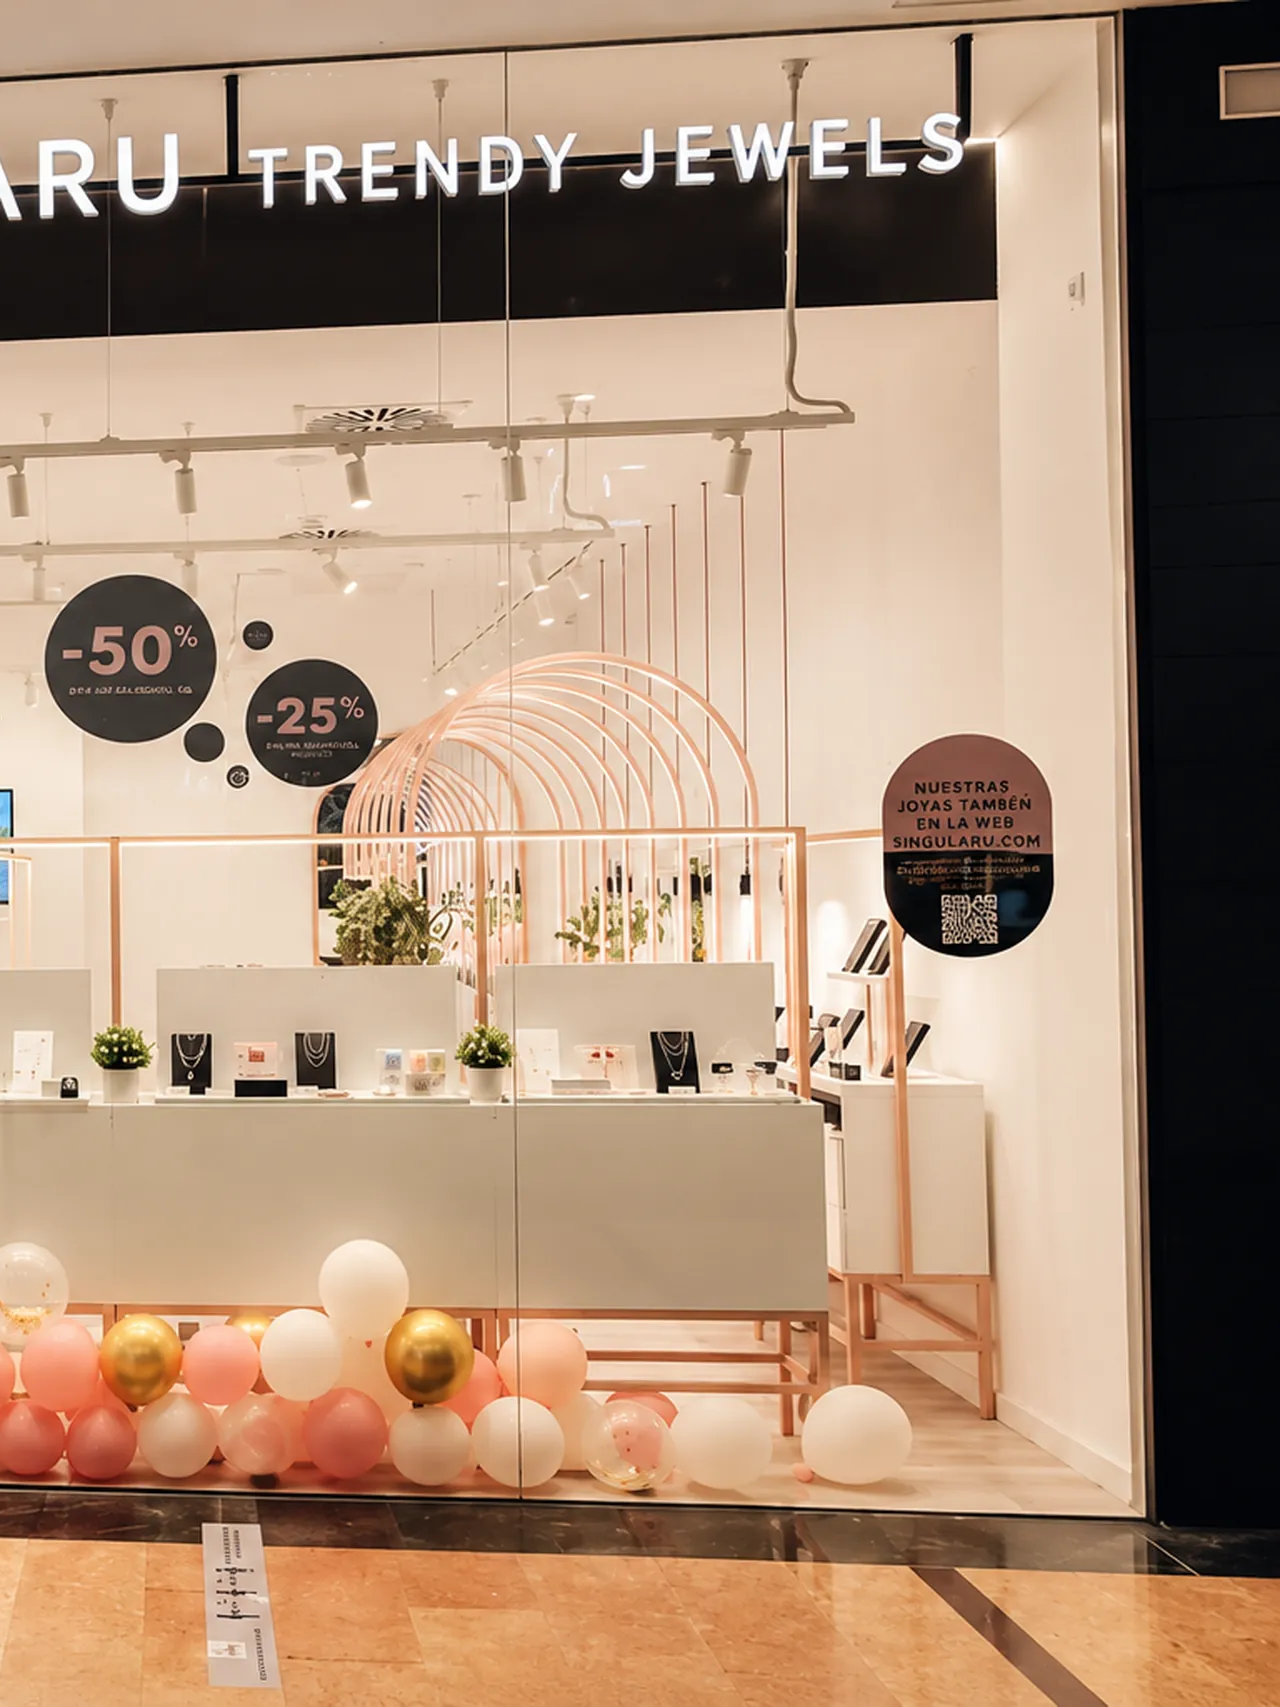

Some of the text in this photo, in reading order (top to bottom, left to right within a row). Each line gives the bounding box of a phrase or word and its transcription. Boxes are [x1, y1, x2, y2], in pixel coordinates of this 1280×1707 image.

[247, 131, 578, 208] TRENDY
[620, 112, 966, 190] JEWELS
[62, 624, 199, 676] -50%
[256, 695, 365, 735] -25%
[914, 780, 1010, 795] NUESTRAS
[897, 799, 953, 813] JOYAS
[916, 815, 1014, 831] EN LA WEB
[892, 834, 1041, 849] SINGULARU.COM
